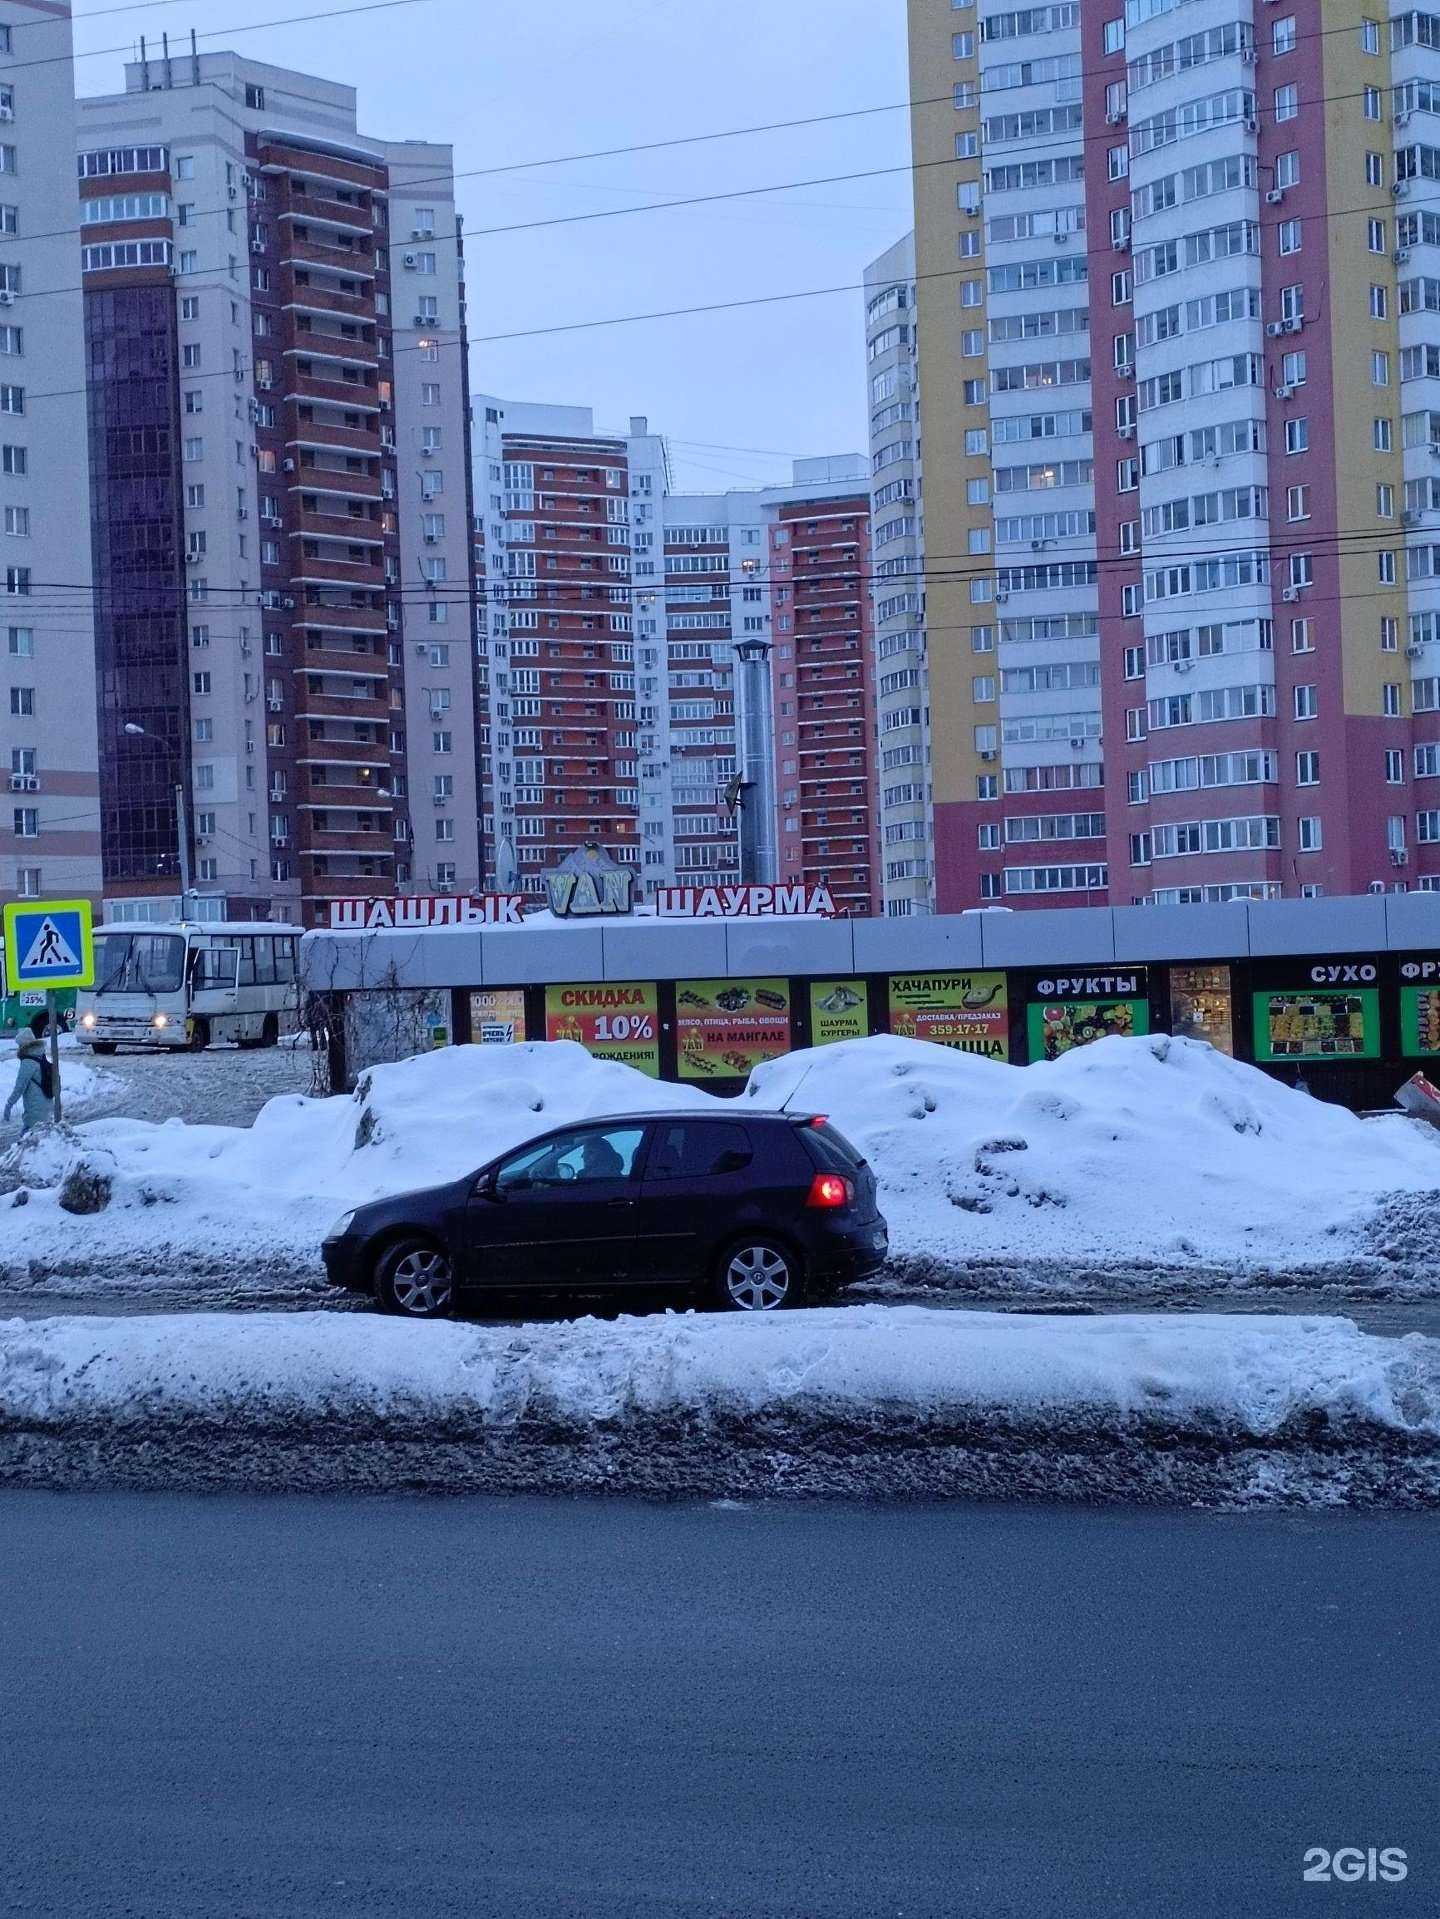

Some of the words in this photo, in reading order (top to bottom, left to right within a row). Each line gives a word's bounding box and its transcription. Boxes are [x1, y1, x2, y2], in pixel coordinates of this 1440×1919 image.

[547, 870, 634, 914] VAN
[657, 884, 837, 917] ШАУРМА
[330, 895, 523, 929] ШАШЛЫК
[1311, 964, 1377, 982] СУХО
[1401, 962, 1440, 978] ФР
[892, 978, 972, 992] ХАЧАПУРИ
[1037, 976, 1137, 994] ФРУКТЫ
[561, 988, 645, 1008] СКИДКА
[594, 1015, 653, 1040] 10%
[820, 1019, 858, 1027] ШАУРМА
[820, 1029, 860, 1037] БУРГЕРЫ
[706, 1032, 725, 1043] НА
[727, 1031, 785, 1042] МАНГАЛЕ
